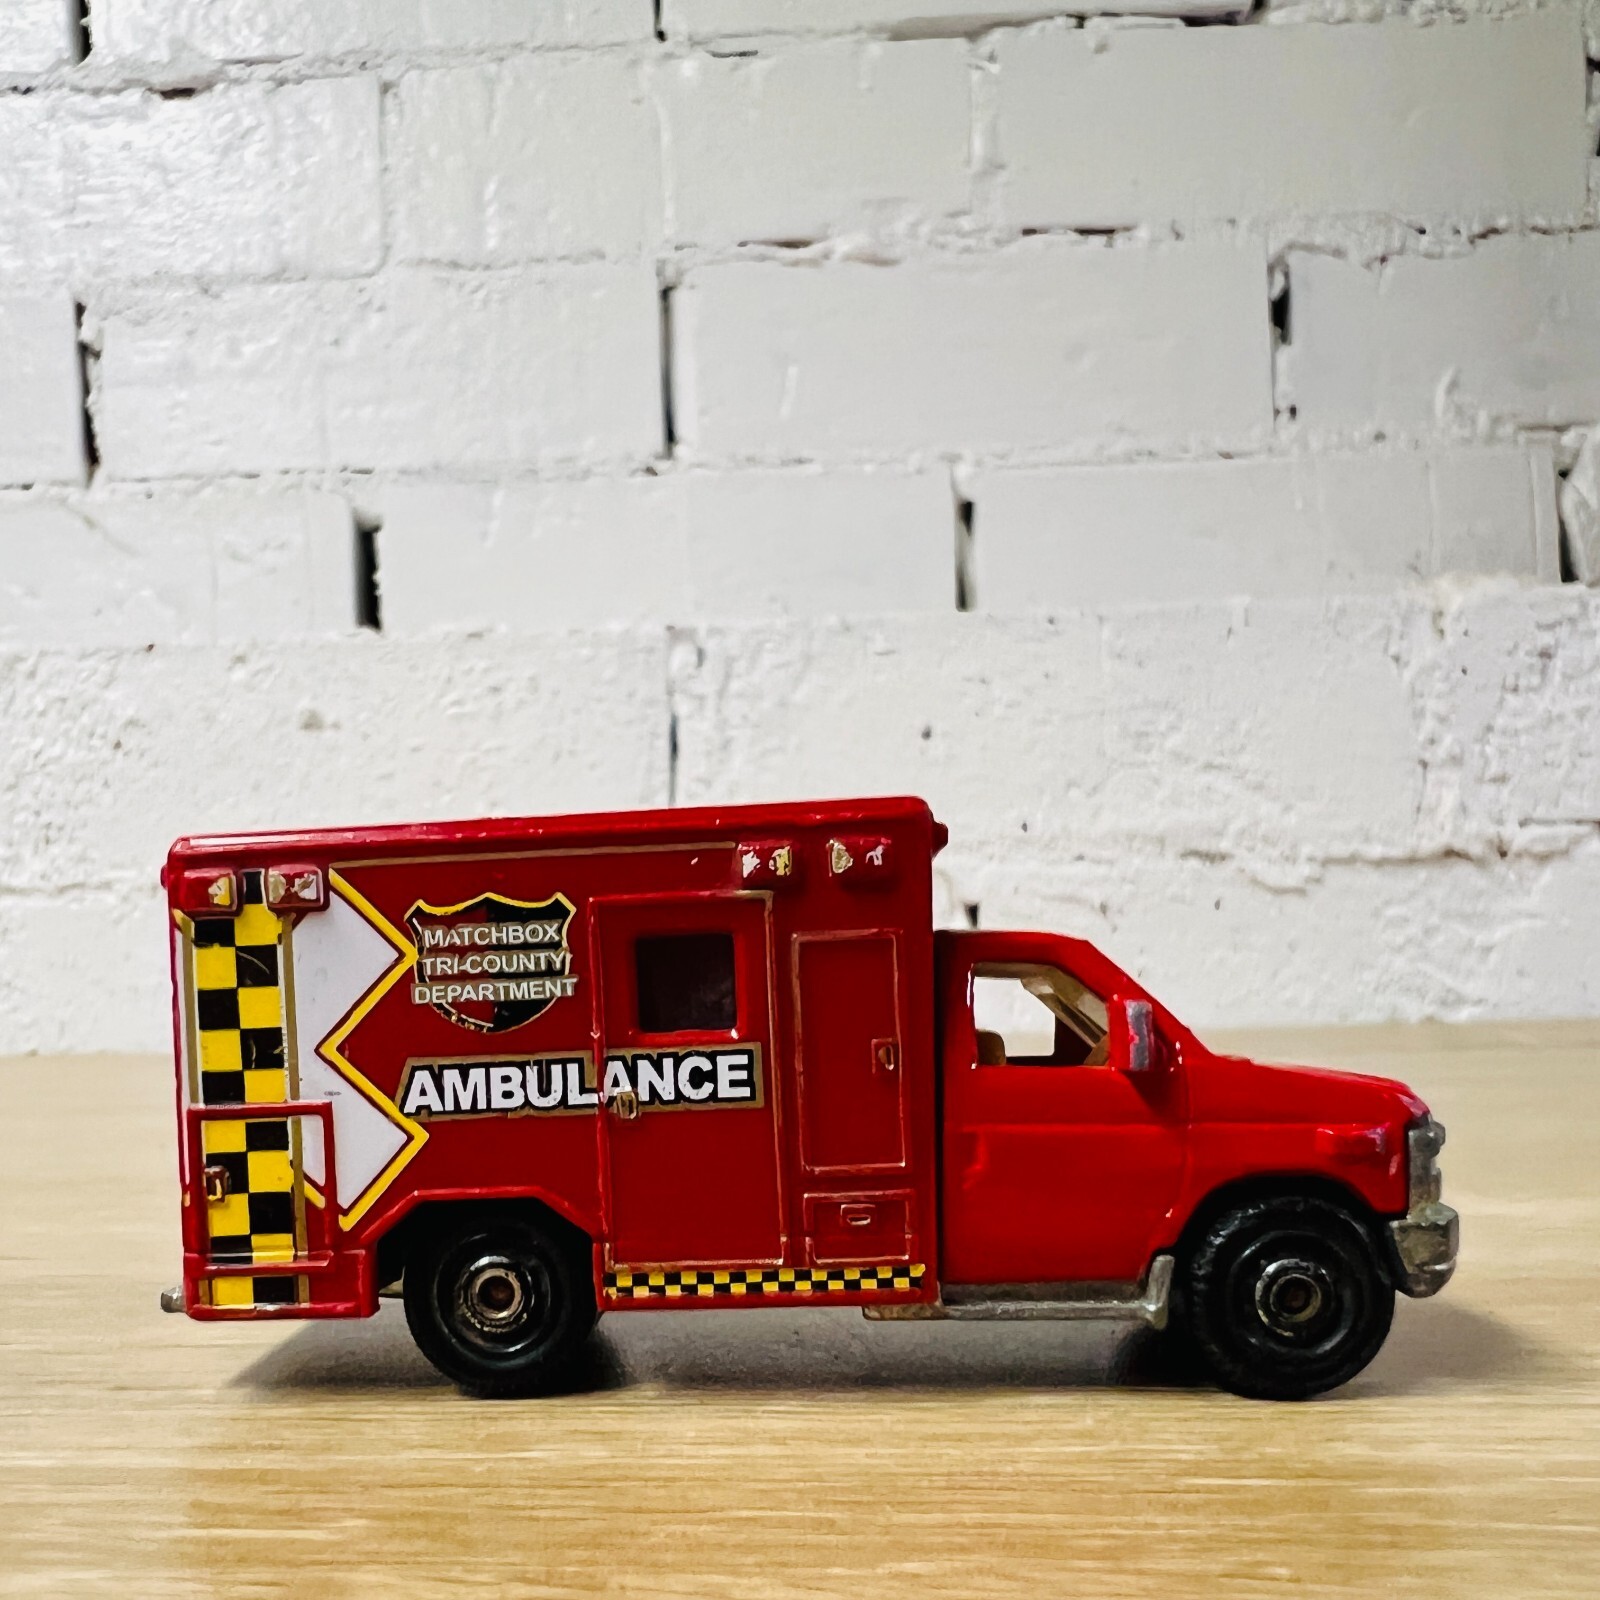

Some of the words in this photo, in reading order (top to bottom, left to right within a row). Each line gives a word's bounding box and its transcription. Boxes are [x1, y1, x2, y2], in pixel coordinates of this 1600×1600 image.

[423, 923, 560, 948] MATCHBOX
[421, 951, 567, 976] TRI-COUNTY
[414, 977, 579, 1004] DEPARTMENT
[403, 1054, 751, 1115] AMBULANCE
